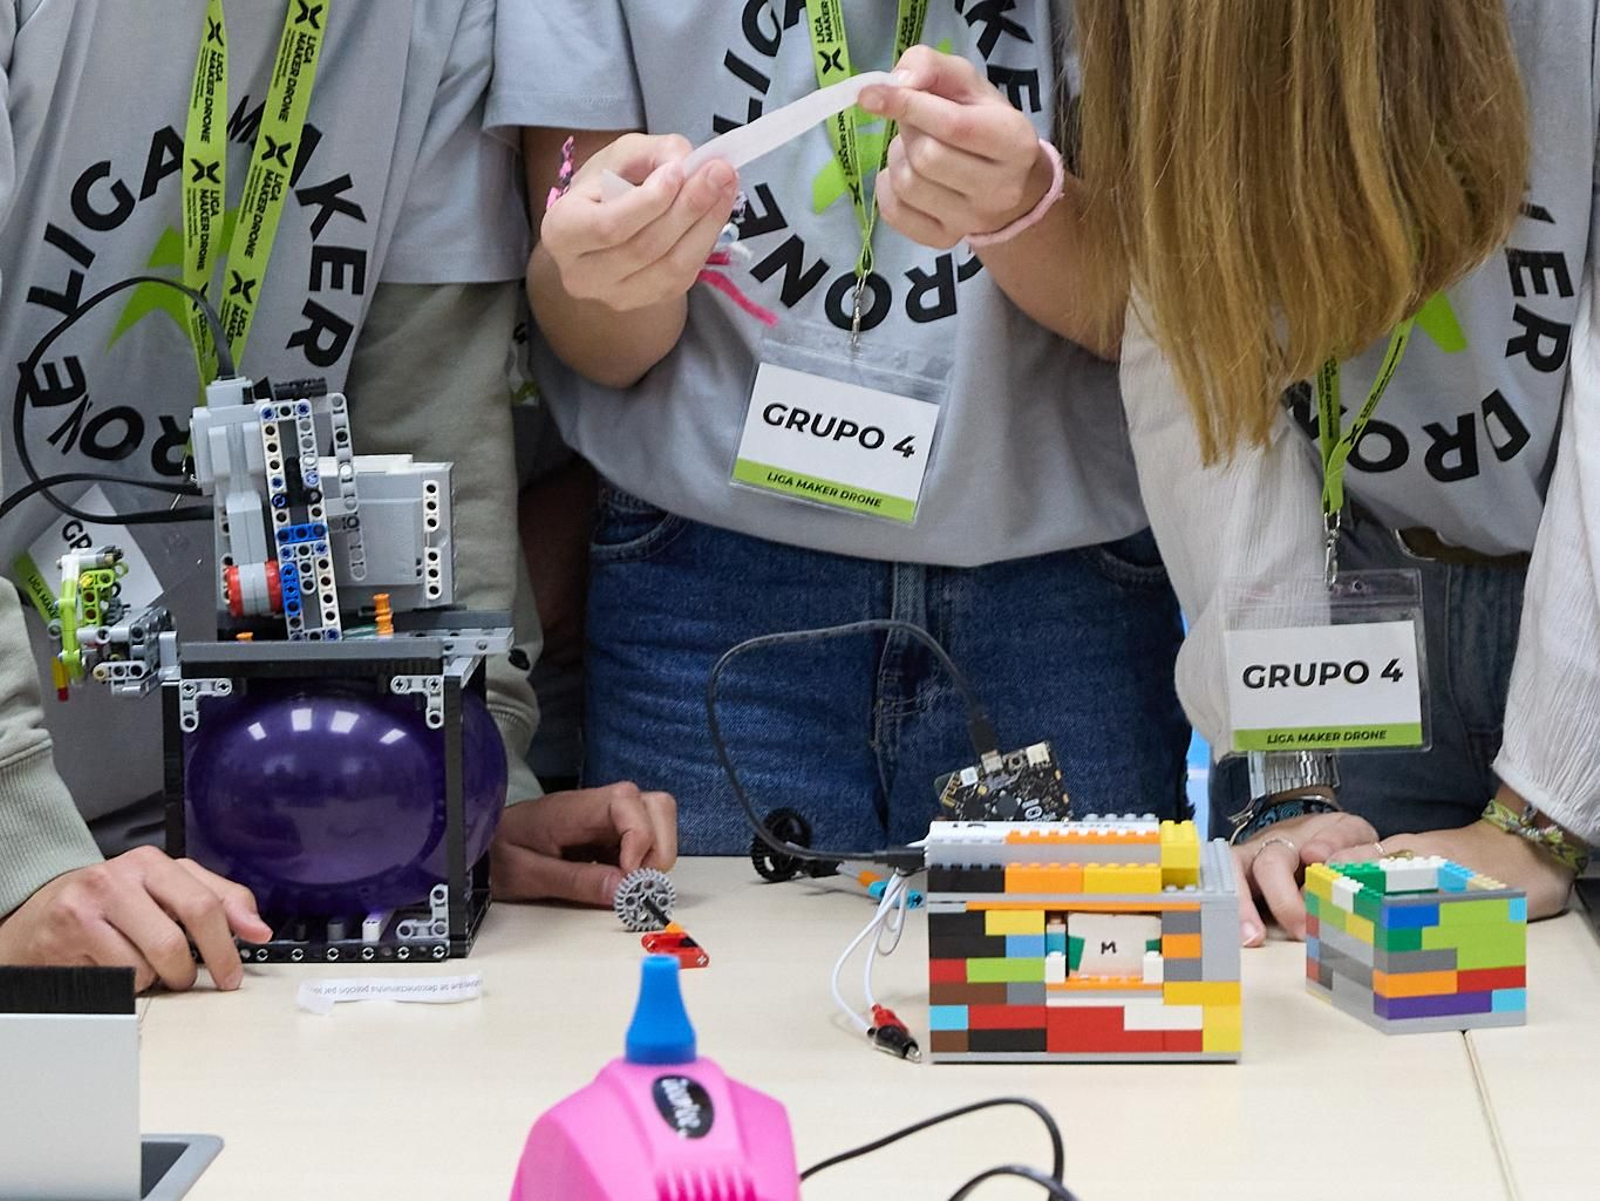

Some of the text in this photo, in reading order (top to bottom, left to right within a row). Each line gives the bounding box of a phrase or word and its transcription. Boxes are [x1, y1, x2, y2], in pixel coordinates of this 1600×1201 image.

[815, 17, 825, 43] LIGA
[820, 0, 833, 43] MAKER
[289, 31, 308, 77] MAKER
[303, 35, 317, 64] LIGA
[201, 49, 217, 143] MAKER DRONE
[278, 78, 297, 123] DRONE
[200, 188, 210, 232] MAKER
[256, 168, 275, 214] MAKER
[26, 125, 184, 317] LIGA
[244, 214, 263, 259] DRONE
[732, 183, 984, 332] RONE
[763, 402, 917, 459] GRUPO 4
[766, 471, 882, 508] LIGA MAKER DRONE
[1242, 658, 1404, 689] GRUPO 4
[1266, 730, 1388, 744] LIGA MAKER DRONE
[1101, 940, 1117, 955] M
